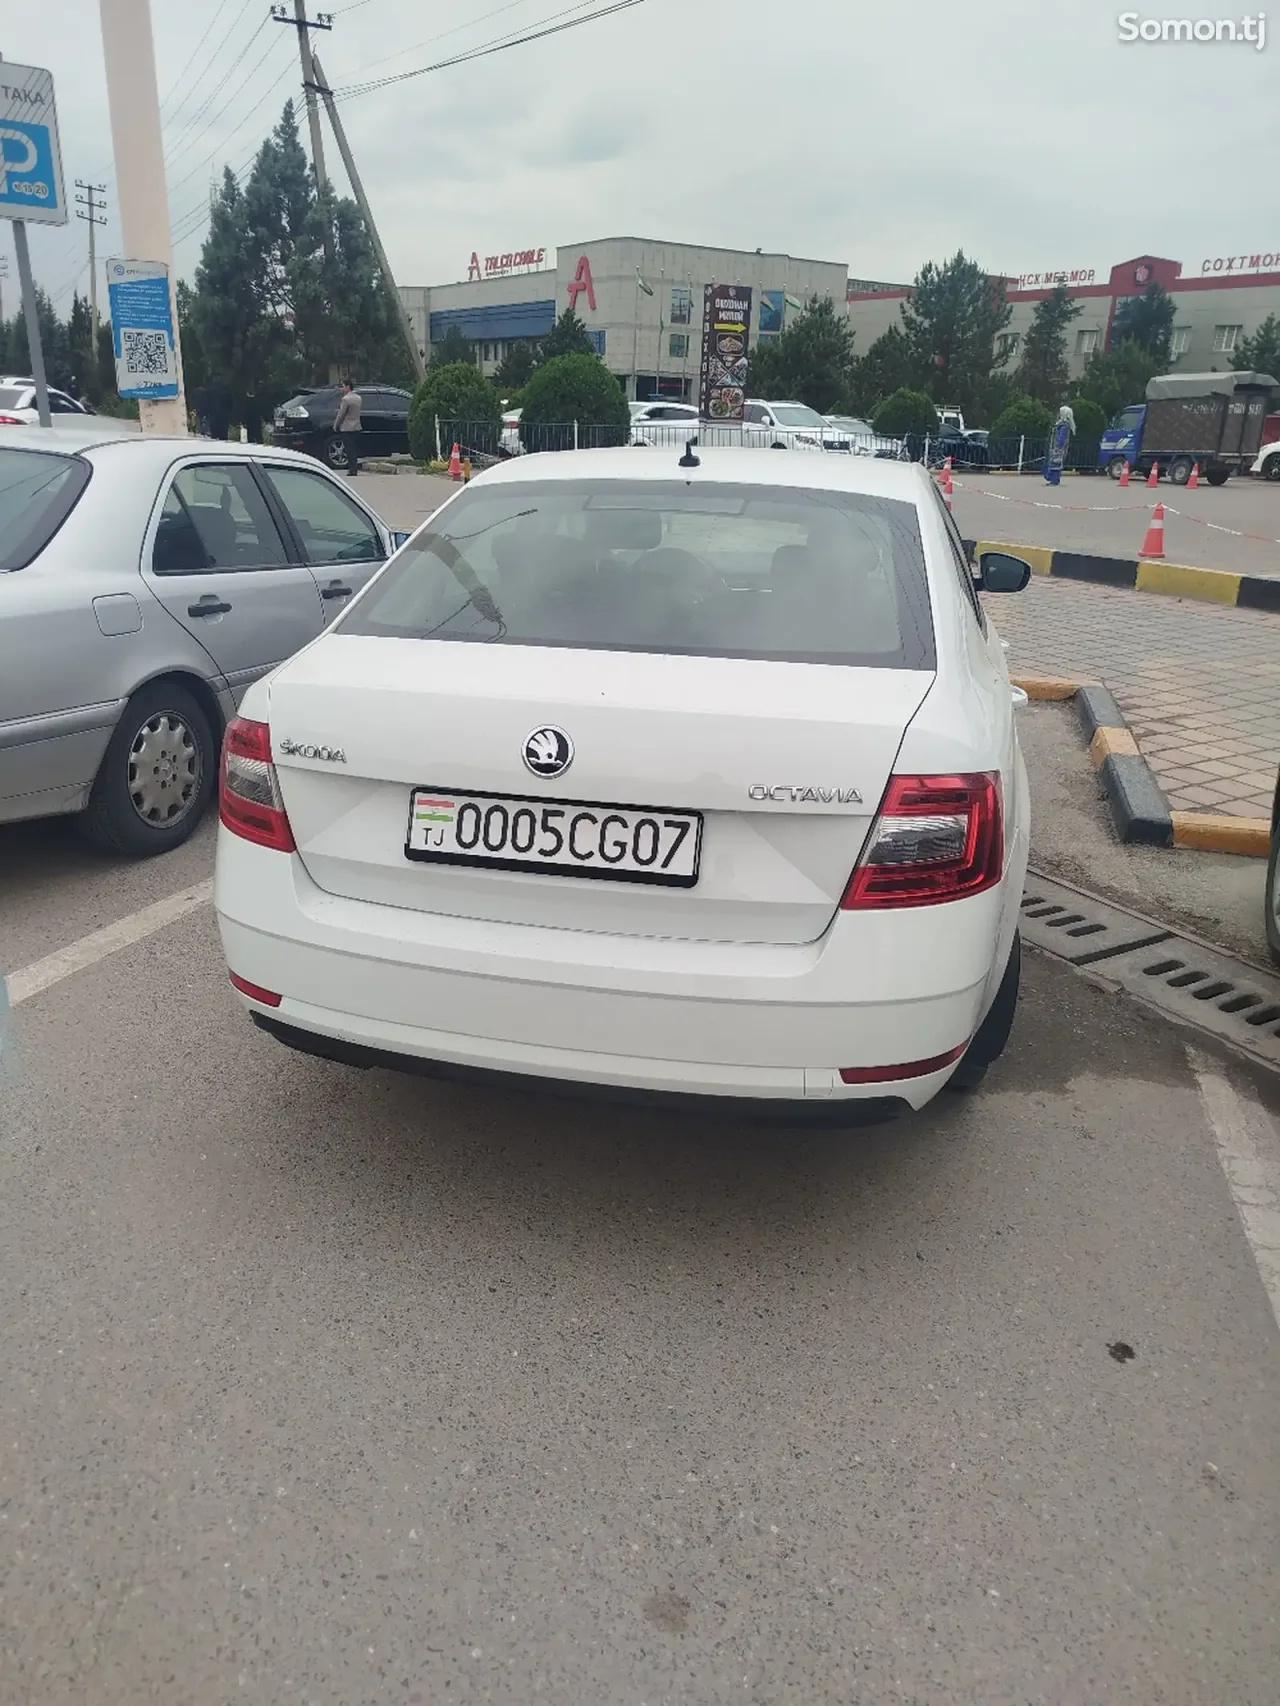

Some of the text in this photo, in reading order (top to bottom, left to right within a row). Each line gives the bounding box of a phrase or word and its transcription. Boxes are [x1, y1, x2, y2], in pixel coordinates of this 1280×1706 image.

[35, 184, 48, 196] 20
[279, 736, 347, 764] ŠKODA
[747, 783, 865, 804] OCTAVIA
[422, 801, 692, 869] TJ 0005CG07
